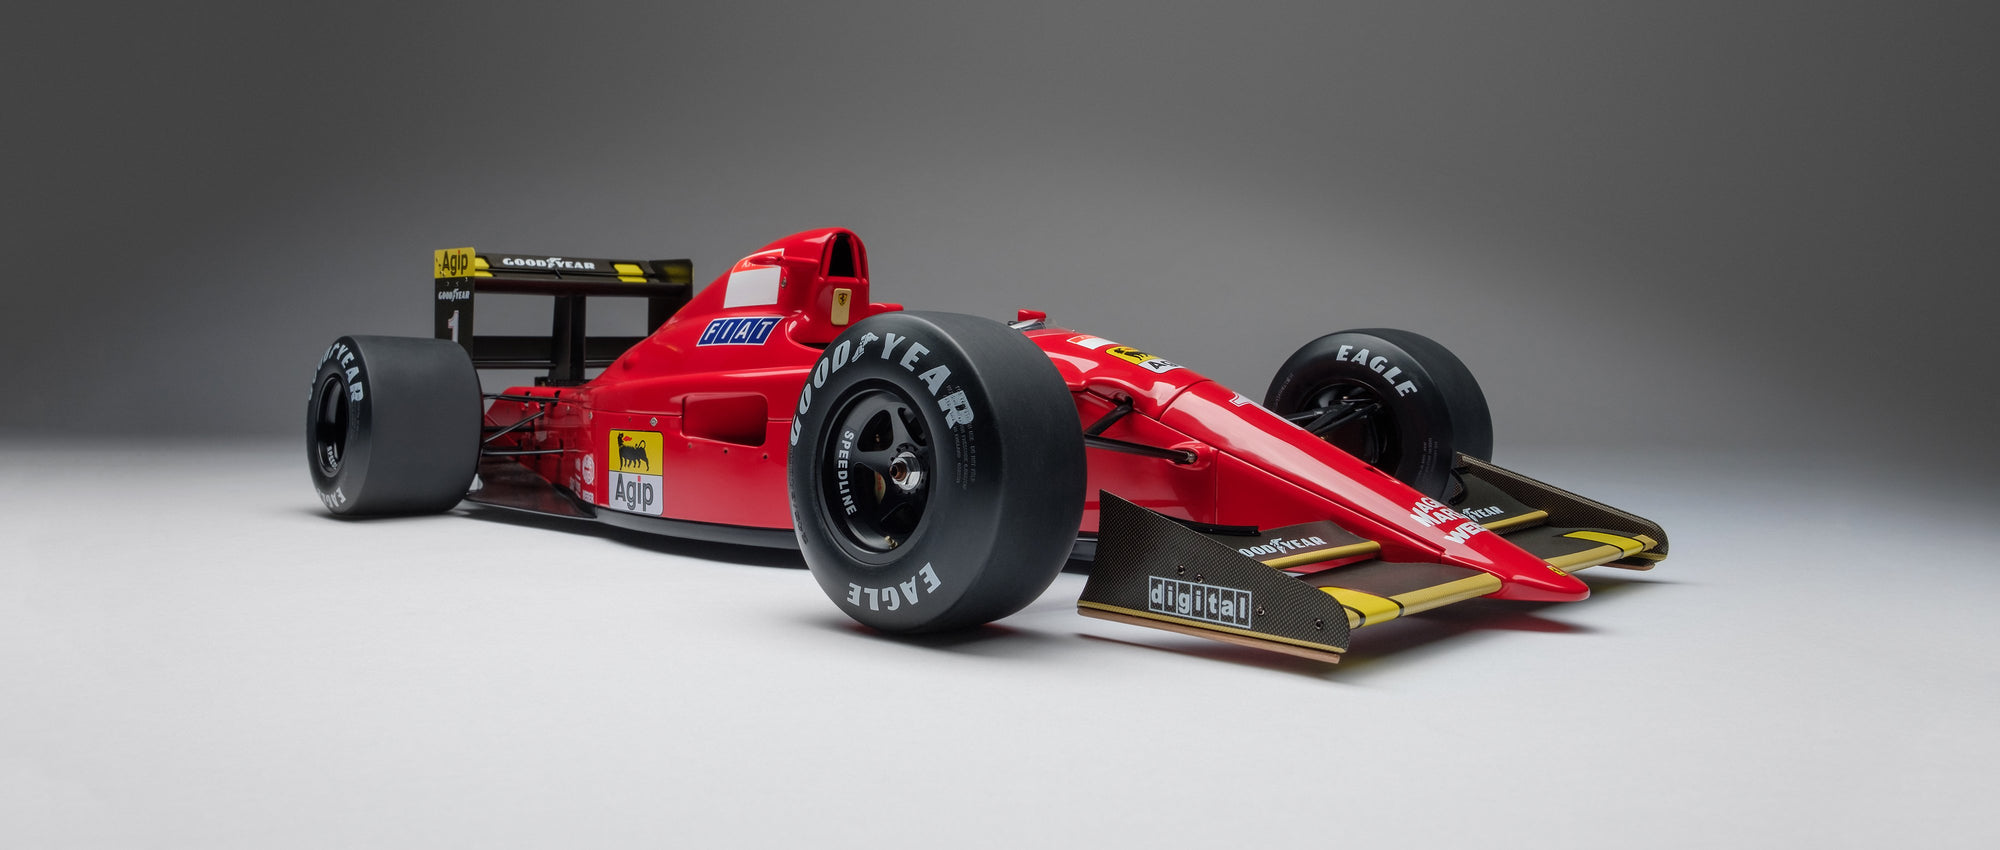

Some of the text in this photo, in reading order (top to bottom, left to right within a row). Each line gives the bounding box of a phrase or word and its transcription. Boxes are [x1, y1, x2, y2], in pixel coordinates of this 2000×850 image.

[442, 250, 468, 276] Agip
[503, 257, 595, 269] GOODYEAR
[438, 288, 470, 302] GOODYEAR
[704, 321, 773, 340] FIAT
[1336, 345, 1418, 397] EAGLE
[790, 331, 975, 447] GOODYEAR
[327, 445, 338, 469] SPEED
[835, 430, 857, 516] SPEEDLINE
[615, 473, 653, 511] Agip
[1238, 536, 1327, 558] OODYEAR
[847, 562, 942, 612] EAGLE
[1151, 584, 1246, 619] digital
